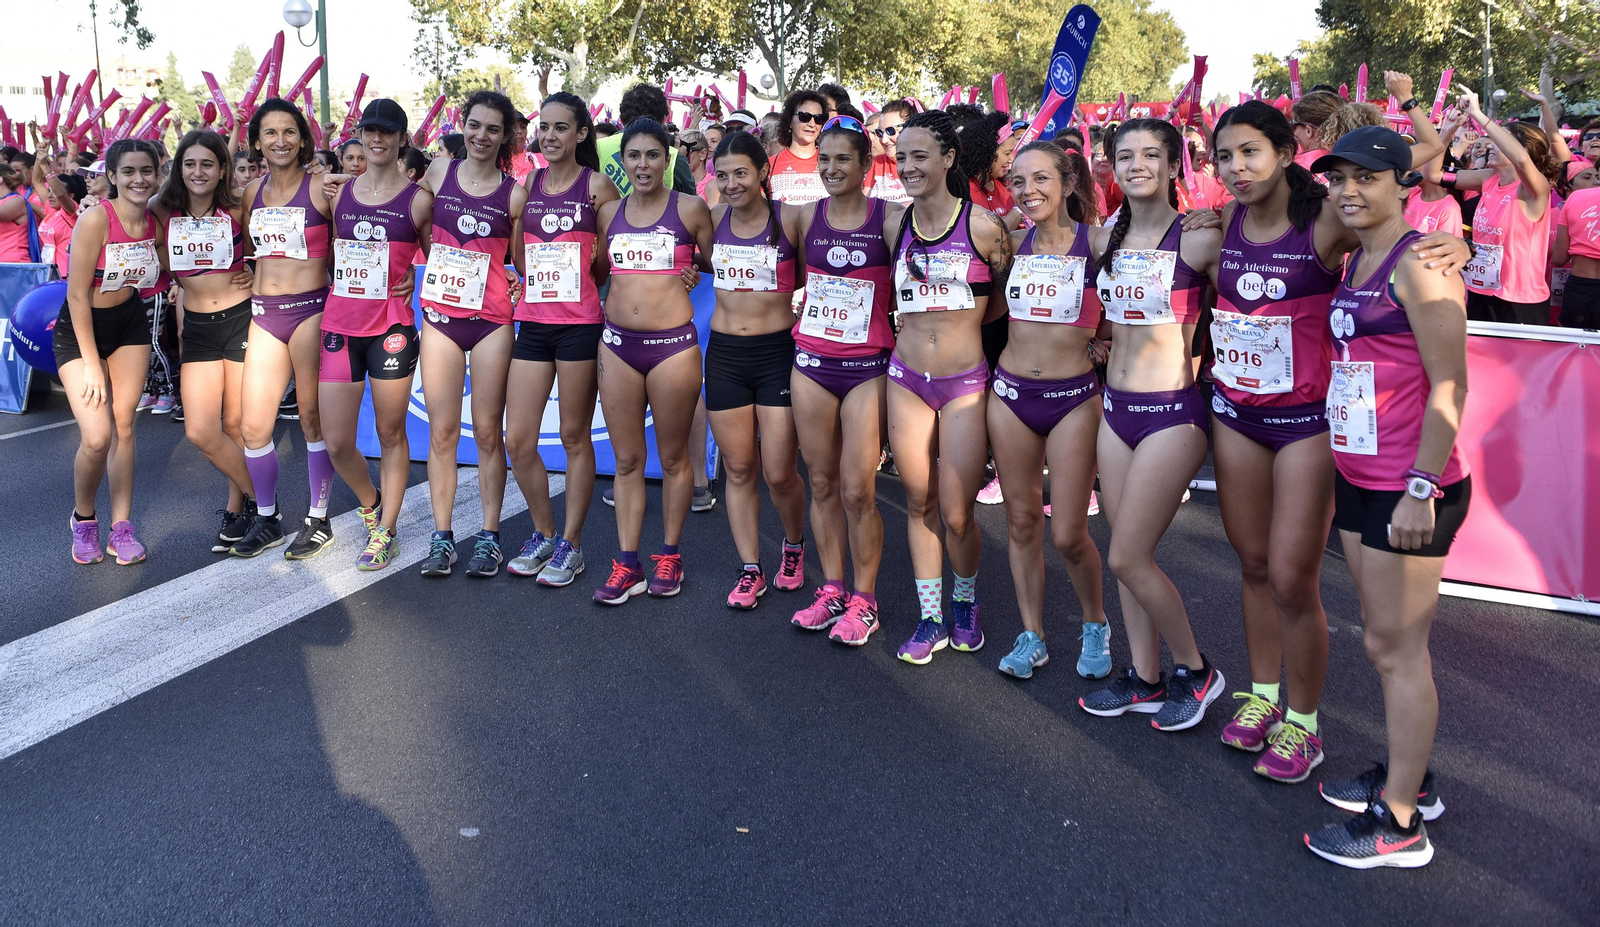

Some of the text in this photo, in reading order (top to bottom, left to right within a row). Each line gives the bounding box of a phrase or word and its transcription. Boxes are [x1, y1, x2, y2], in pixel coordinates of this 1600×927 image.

[1066, 21, 1087, 50] ZURICH
[341, 213, 389, 223] Club Atletismo
[444, 203, 494, 221] Club Atletismo
[461, 219, 486, 233] betta
[544, 218, 569, 227] betta
[357, 226, 382, 236] betta
[263, 234, 286, 244] 016
[813, 239, 868, 248] Club Atletismo
[187, 242, 214, 253] 016
[727, 247, 757, 255] ASTURIANA
[627, 250, 653, 262] 016
[831, 252, 861, 262] betta
[1030, 261, 1061, 269] ASTURIANA
[1117, 262, 1148, 270] ASTURIANA
[1222, 260, 1289, 274] Club Atletismo
[1468, 263, 1486, 275] 016
[123, 267, 146, 277] 016
[345, 267, 368, 279] 016
[537, 271, 560, 282] 016
[728, 267, 755, 279] 016
[440, 273, 466, 288] 016
[1242, 279, 1279, 294] betta
[919, 283, 949, 296] 016
[1026, 283, 1057, 297] 016
[1115, 285, 1145, 300] 016
[822, 305, 848, 320] 016
[1333, 315, 1352, 331] betta
[1228, 325, 1262, 338] ASTURIANA
[643, 336, 684, 345] GSPORT
[1228, 349, 1263, 367] 016
[1242, 367, 1248, 375] 7
[1043, 385, 1088, 398] GSPORT
[1127, 404, 1172, 412] GSPORT
[1263, 414, 1320, 425] GSPORT
